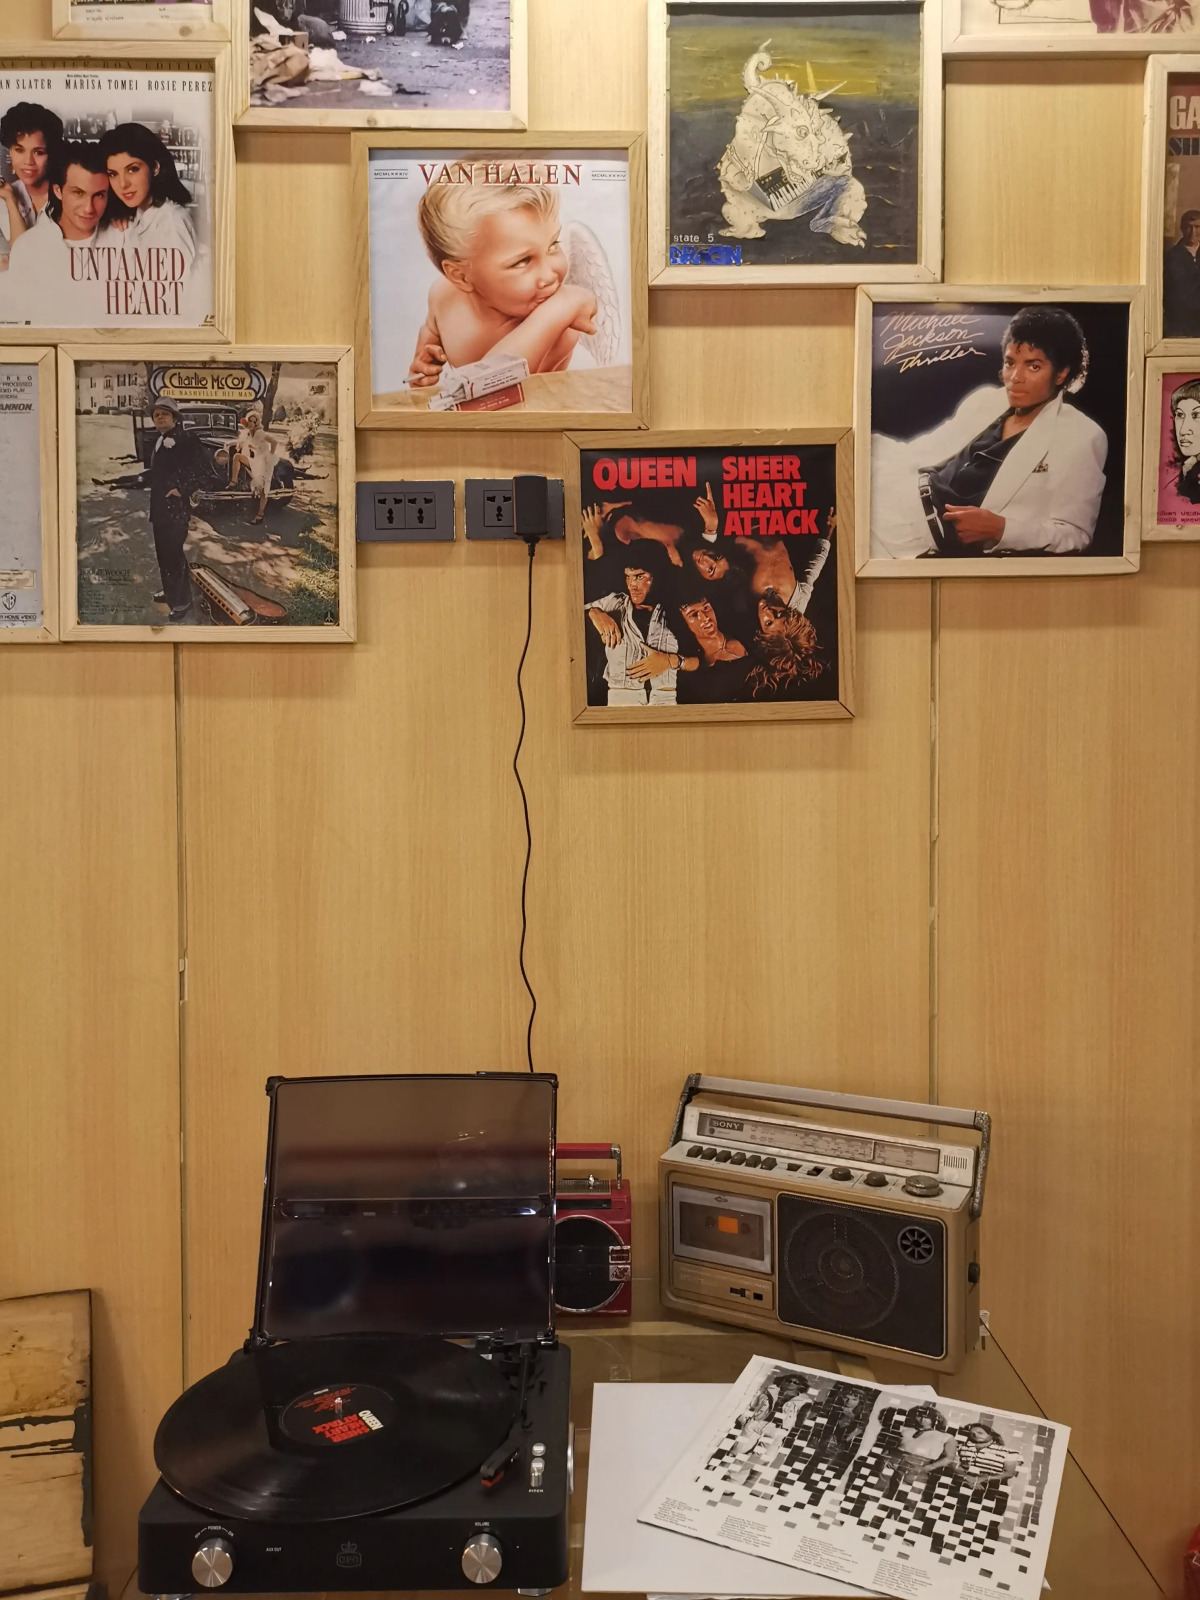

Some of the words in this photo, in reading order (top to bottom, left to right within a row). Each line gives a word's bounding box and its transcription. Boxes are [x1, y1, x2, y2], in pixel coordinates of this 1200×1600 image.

[16, 79, 52, 90] SLATER
[65, 79, 102, 90] MARISA
[108, 79, 138, 91] TOMEI
[148, 80, 177, 91] ROSIE
[182, 81, 213, 92] PEREZ
[417, 163, 476, 186] VAN
[482, 163, 582, 186] HALEN
[673, 234, 699, 242] state
[707, 233, 714, 242] 5
[69, 247, 185, 281] UNTAMED
[105, 281, 184, 315] HEART
[883, 328, 985, 365] Jackson
[896, 345, 986, 373] Thriller
[169, 371, 208, 388] Charlie
[211, 374, 246, 390] McCoy
[179, 389, 218, 397] NASHVILLE
[239, 390, 253, 398] MAN
[592, 456, 697, 491] QUEEN
[722, 454, 801, 480] SHEER
[723, 481, 807, 508] HEART
[724, 508, 819, 536] ATTACK
[712, 1120, 740, 1130] SONY
[358, 1409, 384, 1431] QUEEN
